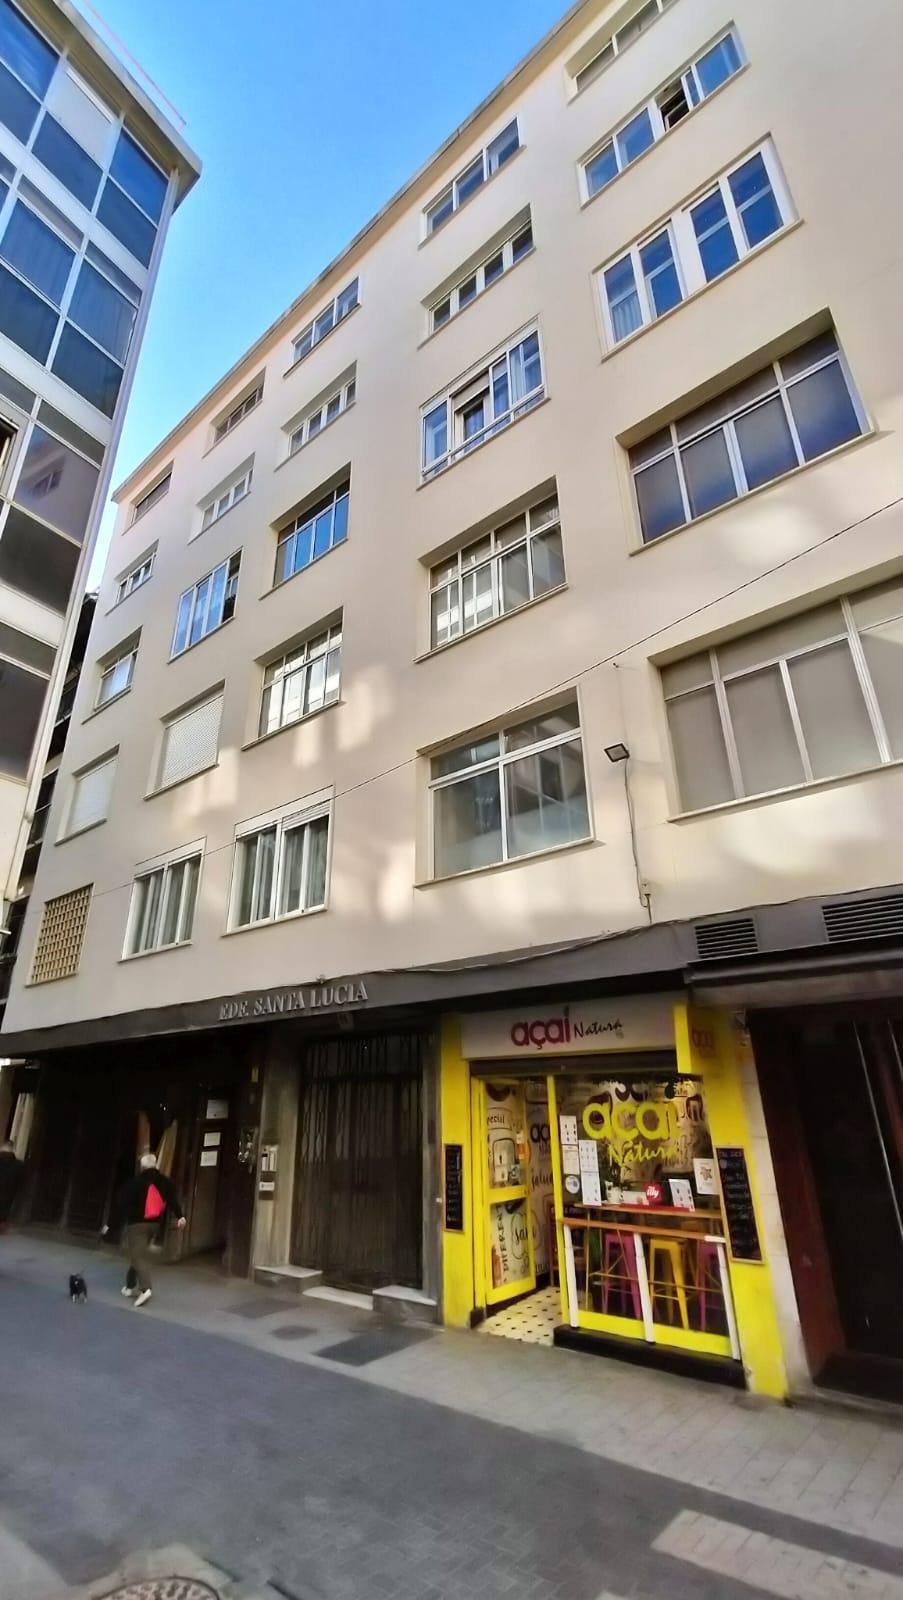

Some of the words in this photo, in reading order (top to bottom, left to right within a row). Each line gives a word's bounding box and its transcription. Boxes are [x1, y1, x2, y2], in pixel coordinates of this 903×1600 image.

[253, 990, 305, 1016] SANTA
[309, 980, 369, 1008] LUCIA
[574, 1020, 623, 1039] Natura
